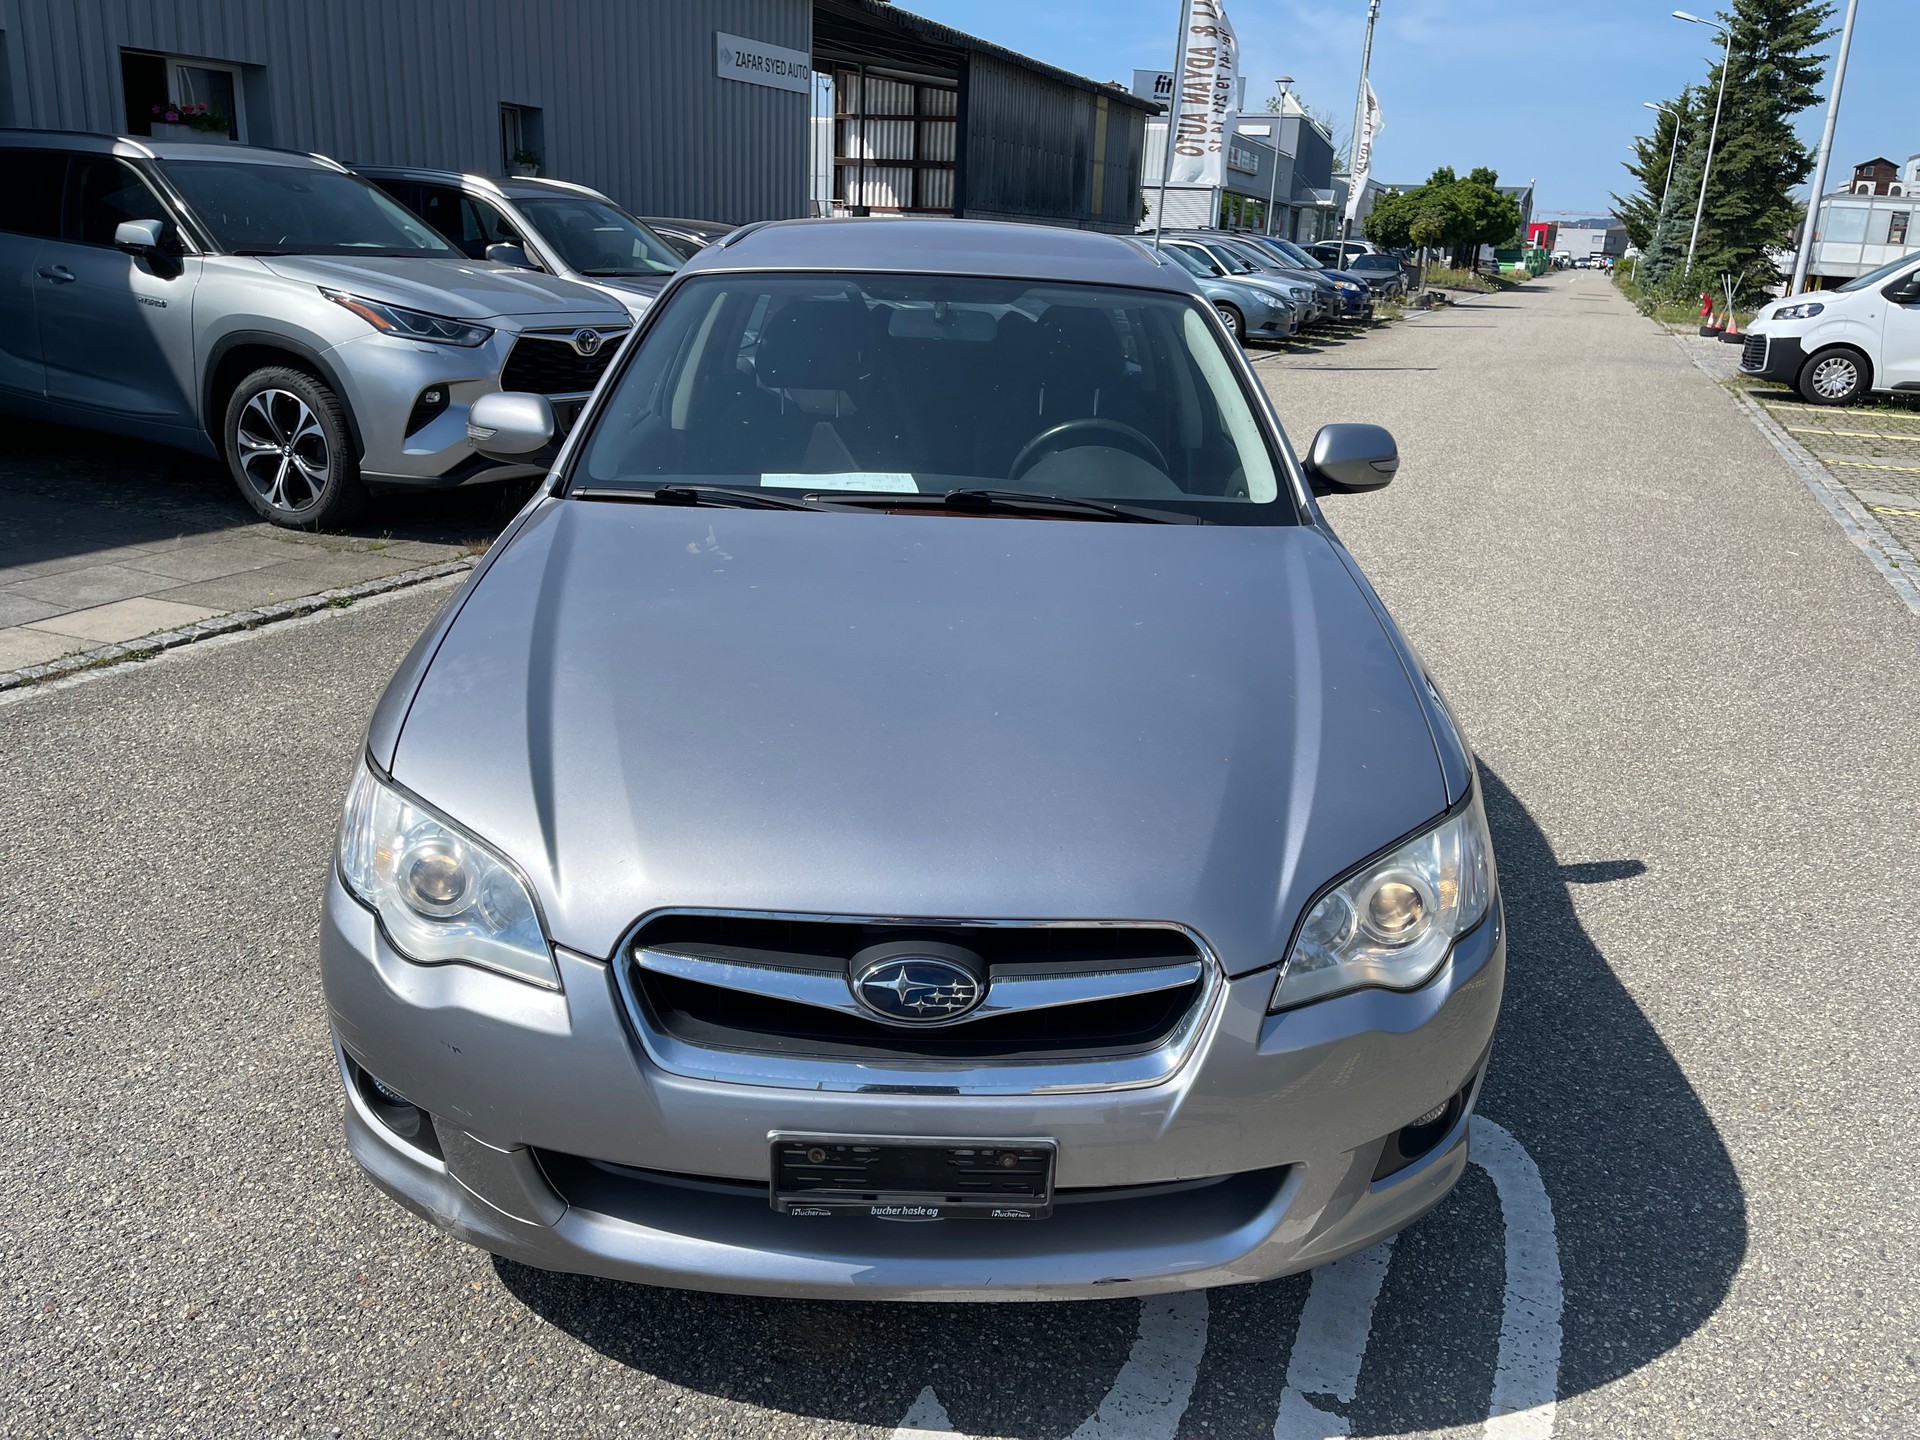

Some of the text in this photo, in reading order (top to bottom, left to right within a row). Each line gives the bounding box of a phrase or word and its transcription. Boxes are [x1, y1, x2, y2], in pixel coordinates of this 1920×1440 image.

[735, 51, 809, 80] ZAFAR SYED AUTO
[1154, 75, 1173, 94] fit
[870, 1206, 939, 1218] bucher hasle ag
